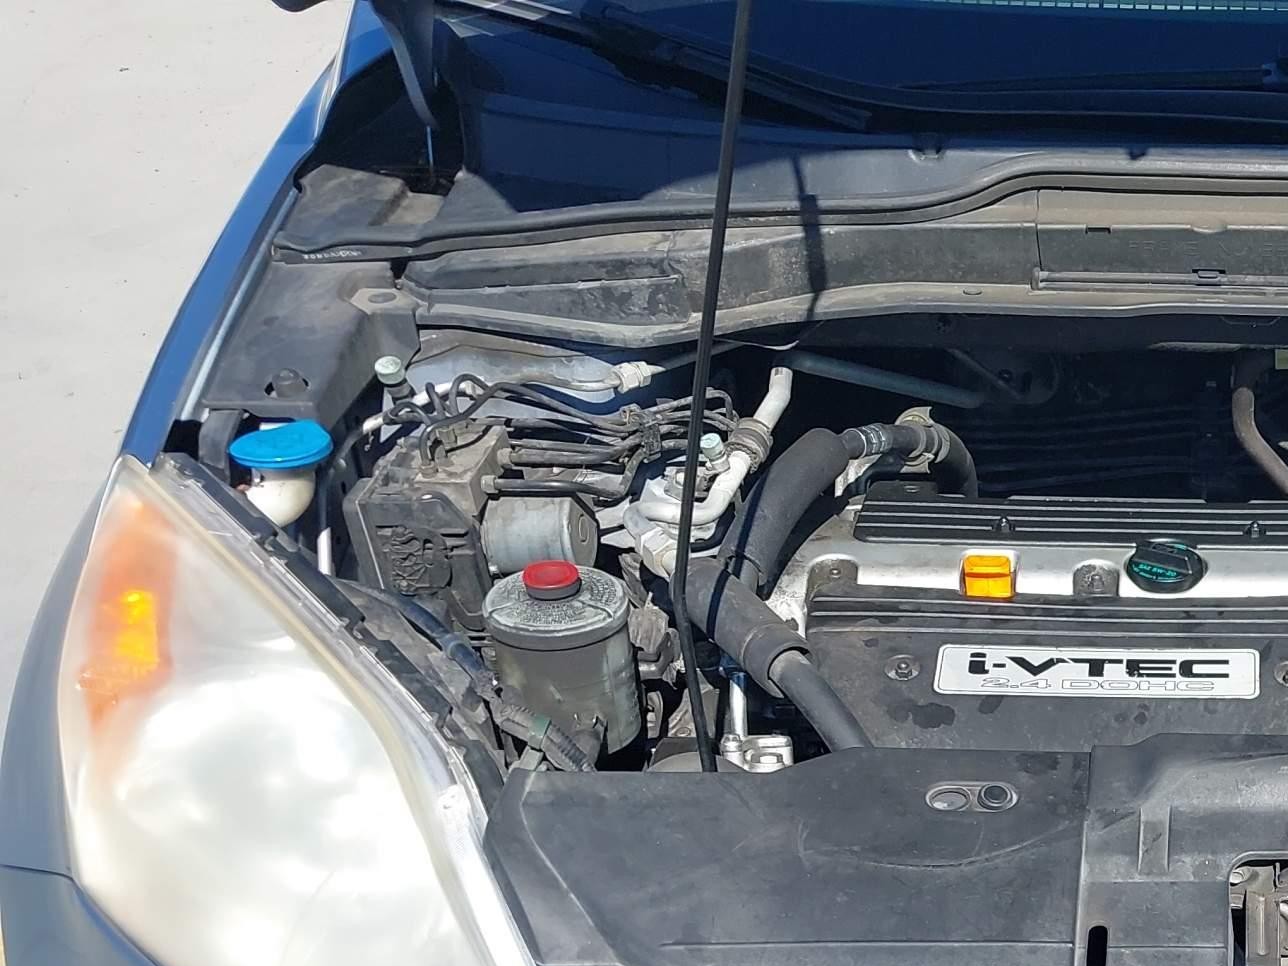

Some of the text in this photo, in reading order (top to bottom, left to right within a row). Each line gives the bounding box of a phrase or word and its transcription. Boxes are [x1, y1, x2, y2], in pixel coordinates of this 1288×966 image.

[968, 652, 1229, 678] i-VTEC
[981, 676, 1215, 692] 2.4 DOHC
